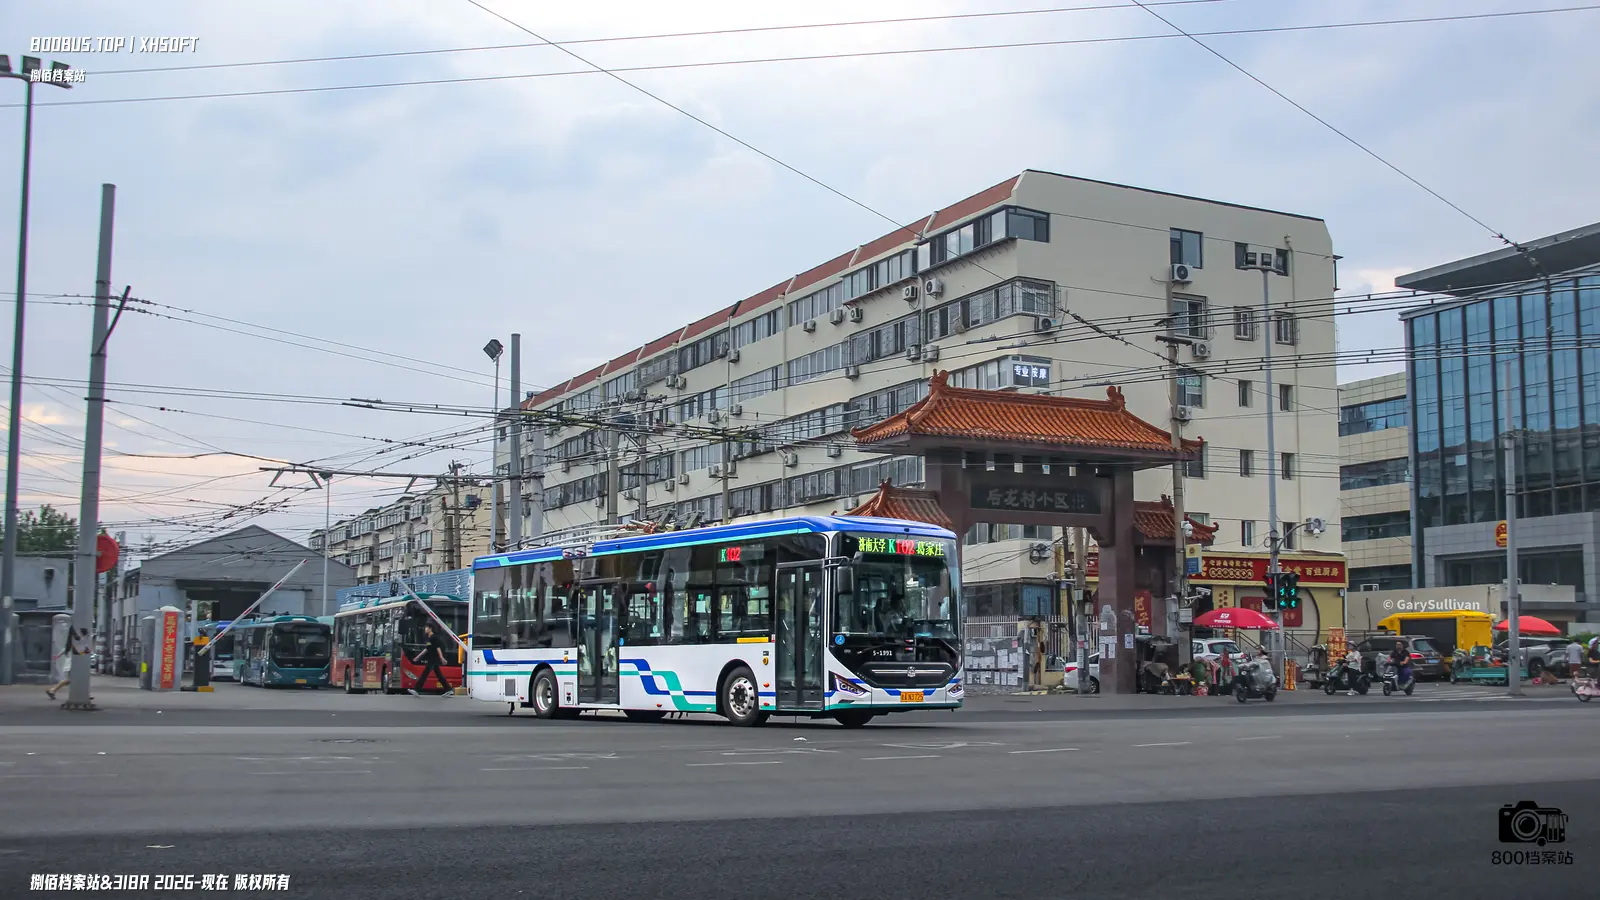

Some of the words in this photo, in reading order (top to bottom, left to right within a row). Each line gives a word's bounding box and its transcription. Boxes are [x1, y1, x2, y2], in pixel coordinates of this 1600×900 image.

[720, 546, 741, 563] K102
[888, 538, 916, 555] K102
[916, 540, 944, 556] 葛家庄
[872, 649, 893, 657] S-1991
